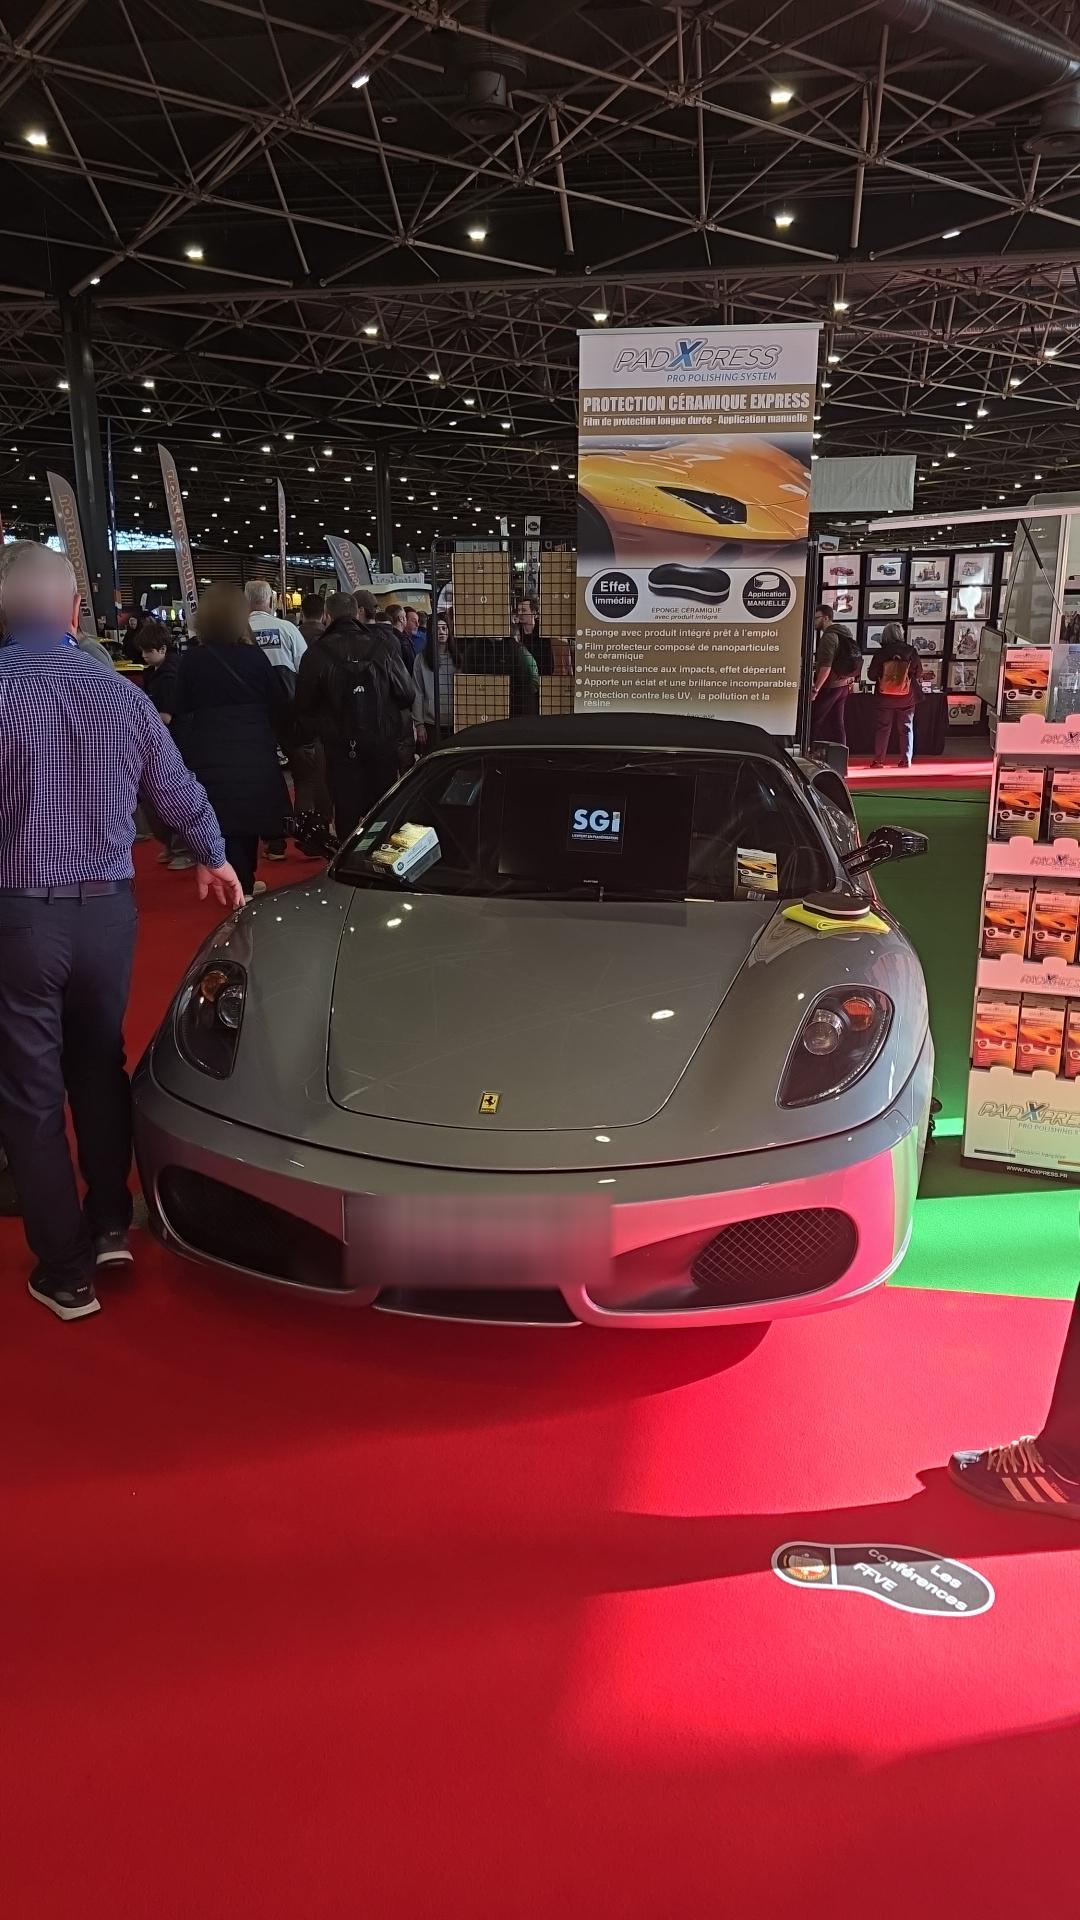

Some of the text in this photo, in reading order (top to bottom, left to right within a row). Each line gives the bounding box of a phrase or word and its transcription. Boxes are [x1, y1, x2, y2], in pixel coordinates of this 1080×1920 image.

[614, 338, 783, 372] PADXPRESS
[667, 372, 777, 383] PRO POLISHING SYSTEM
[583, 392, 810, 413] PROTECTION CÉRAMIQUE EXPRESS
[583, 417, 600, 426] Film
[601, 417, 612, 426] de
[613, 417, 656, 427] protection
[657, 416, 686, 426] longue
[687, 415, 713, 425] durée
[718, 414, 766, 425] Application
[767, 413, 808, 423] manuelle
[600, 581, 630, 593] Effet
[595, 596, 635, 605] immédiat
[681, 606, 722, 614] CÉRAMIQUE
[585, 629, 619, 638] Eponge
[644, 629, 677, 638] produit
[679, 629, 711, 638] intégré
[713, 629, 732, 638] prêt
[733, 629, 740, 637] à
[742, 629, 779, 638] l'emploi
[584, 642, 780, 653] Film protecteur composé de nanoparticules
[584, 651, 644, 661] de céramique
[584, 664, 659, 673] Haute-résistance
[720, 666, 740, 674] effet
[742, 666, 786, 675] déperlant
[584, 678, 620, 687] Apporte
[688, 679, 728, 687] brillance
[730, 680, 798, 688] incomparables
[583, 691, 629, 699] Protection
[631, 691, 660, 699] contre
[698, 692, 706, 700] la
[708, 692, 748, 701] pollution
[750, 693, 760, 701] et
[761, 693, 770, 701] la
[583, 699, 611, 708] résine
[978, 1101, 1080, 1128] PADXPRE
[853, 1562, 898, 1592] FFVE
[868, 1549, 968, 1611] conférences
[930, 1564, 962, 1589] Les
